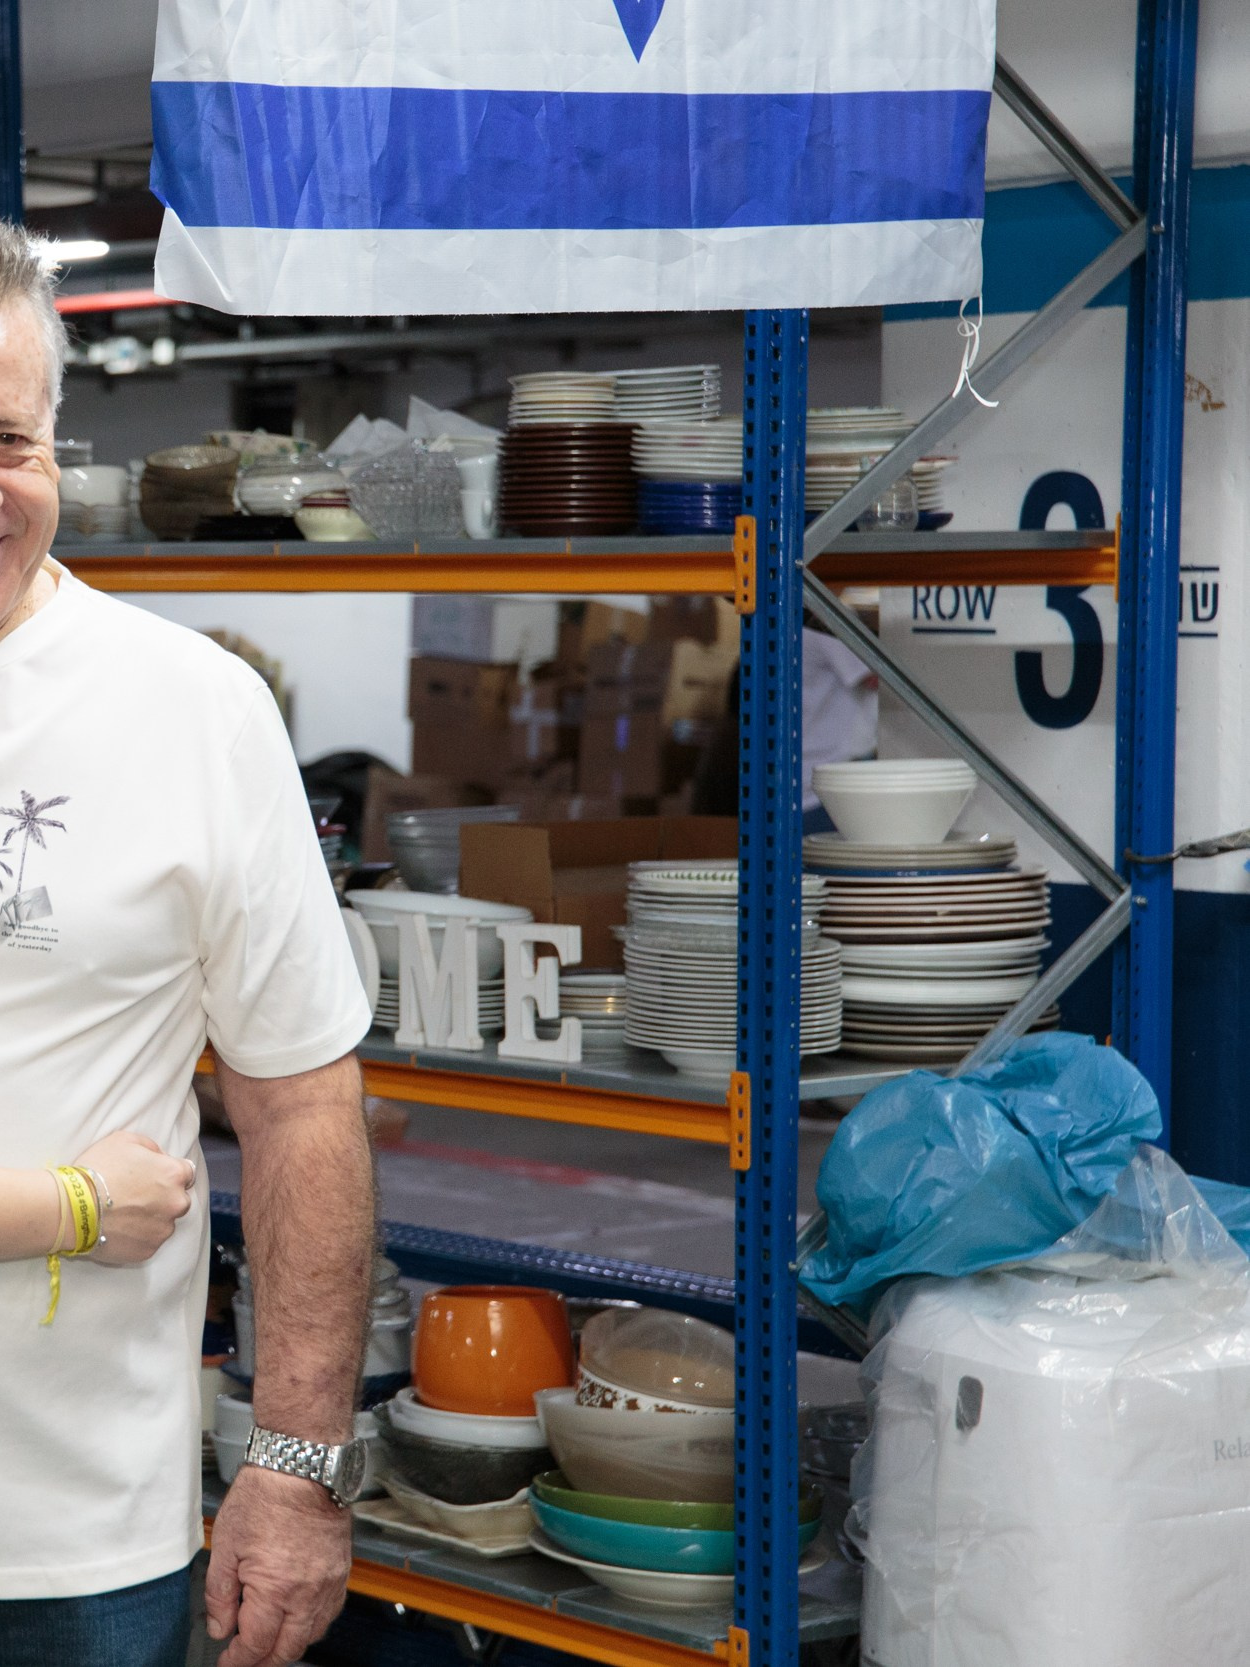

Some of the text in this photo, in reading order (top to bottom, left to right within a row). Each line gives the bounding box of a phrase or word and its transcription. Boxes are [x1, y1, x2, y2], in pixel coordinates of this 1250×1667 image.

[912, 470, 1106, 729] ROW 3
[18, 924, 49, 933] goodbye
[18, 943, 52, 952] yesterday
